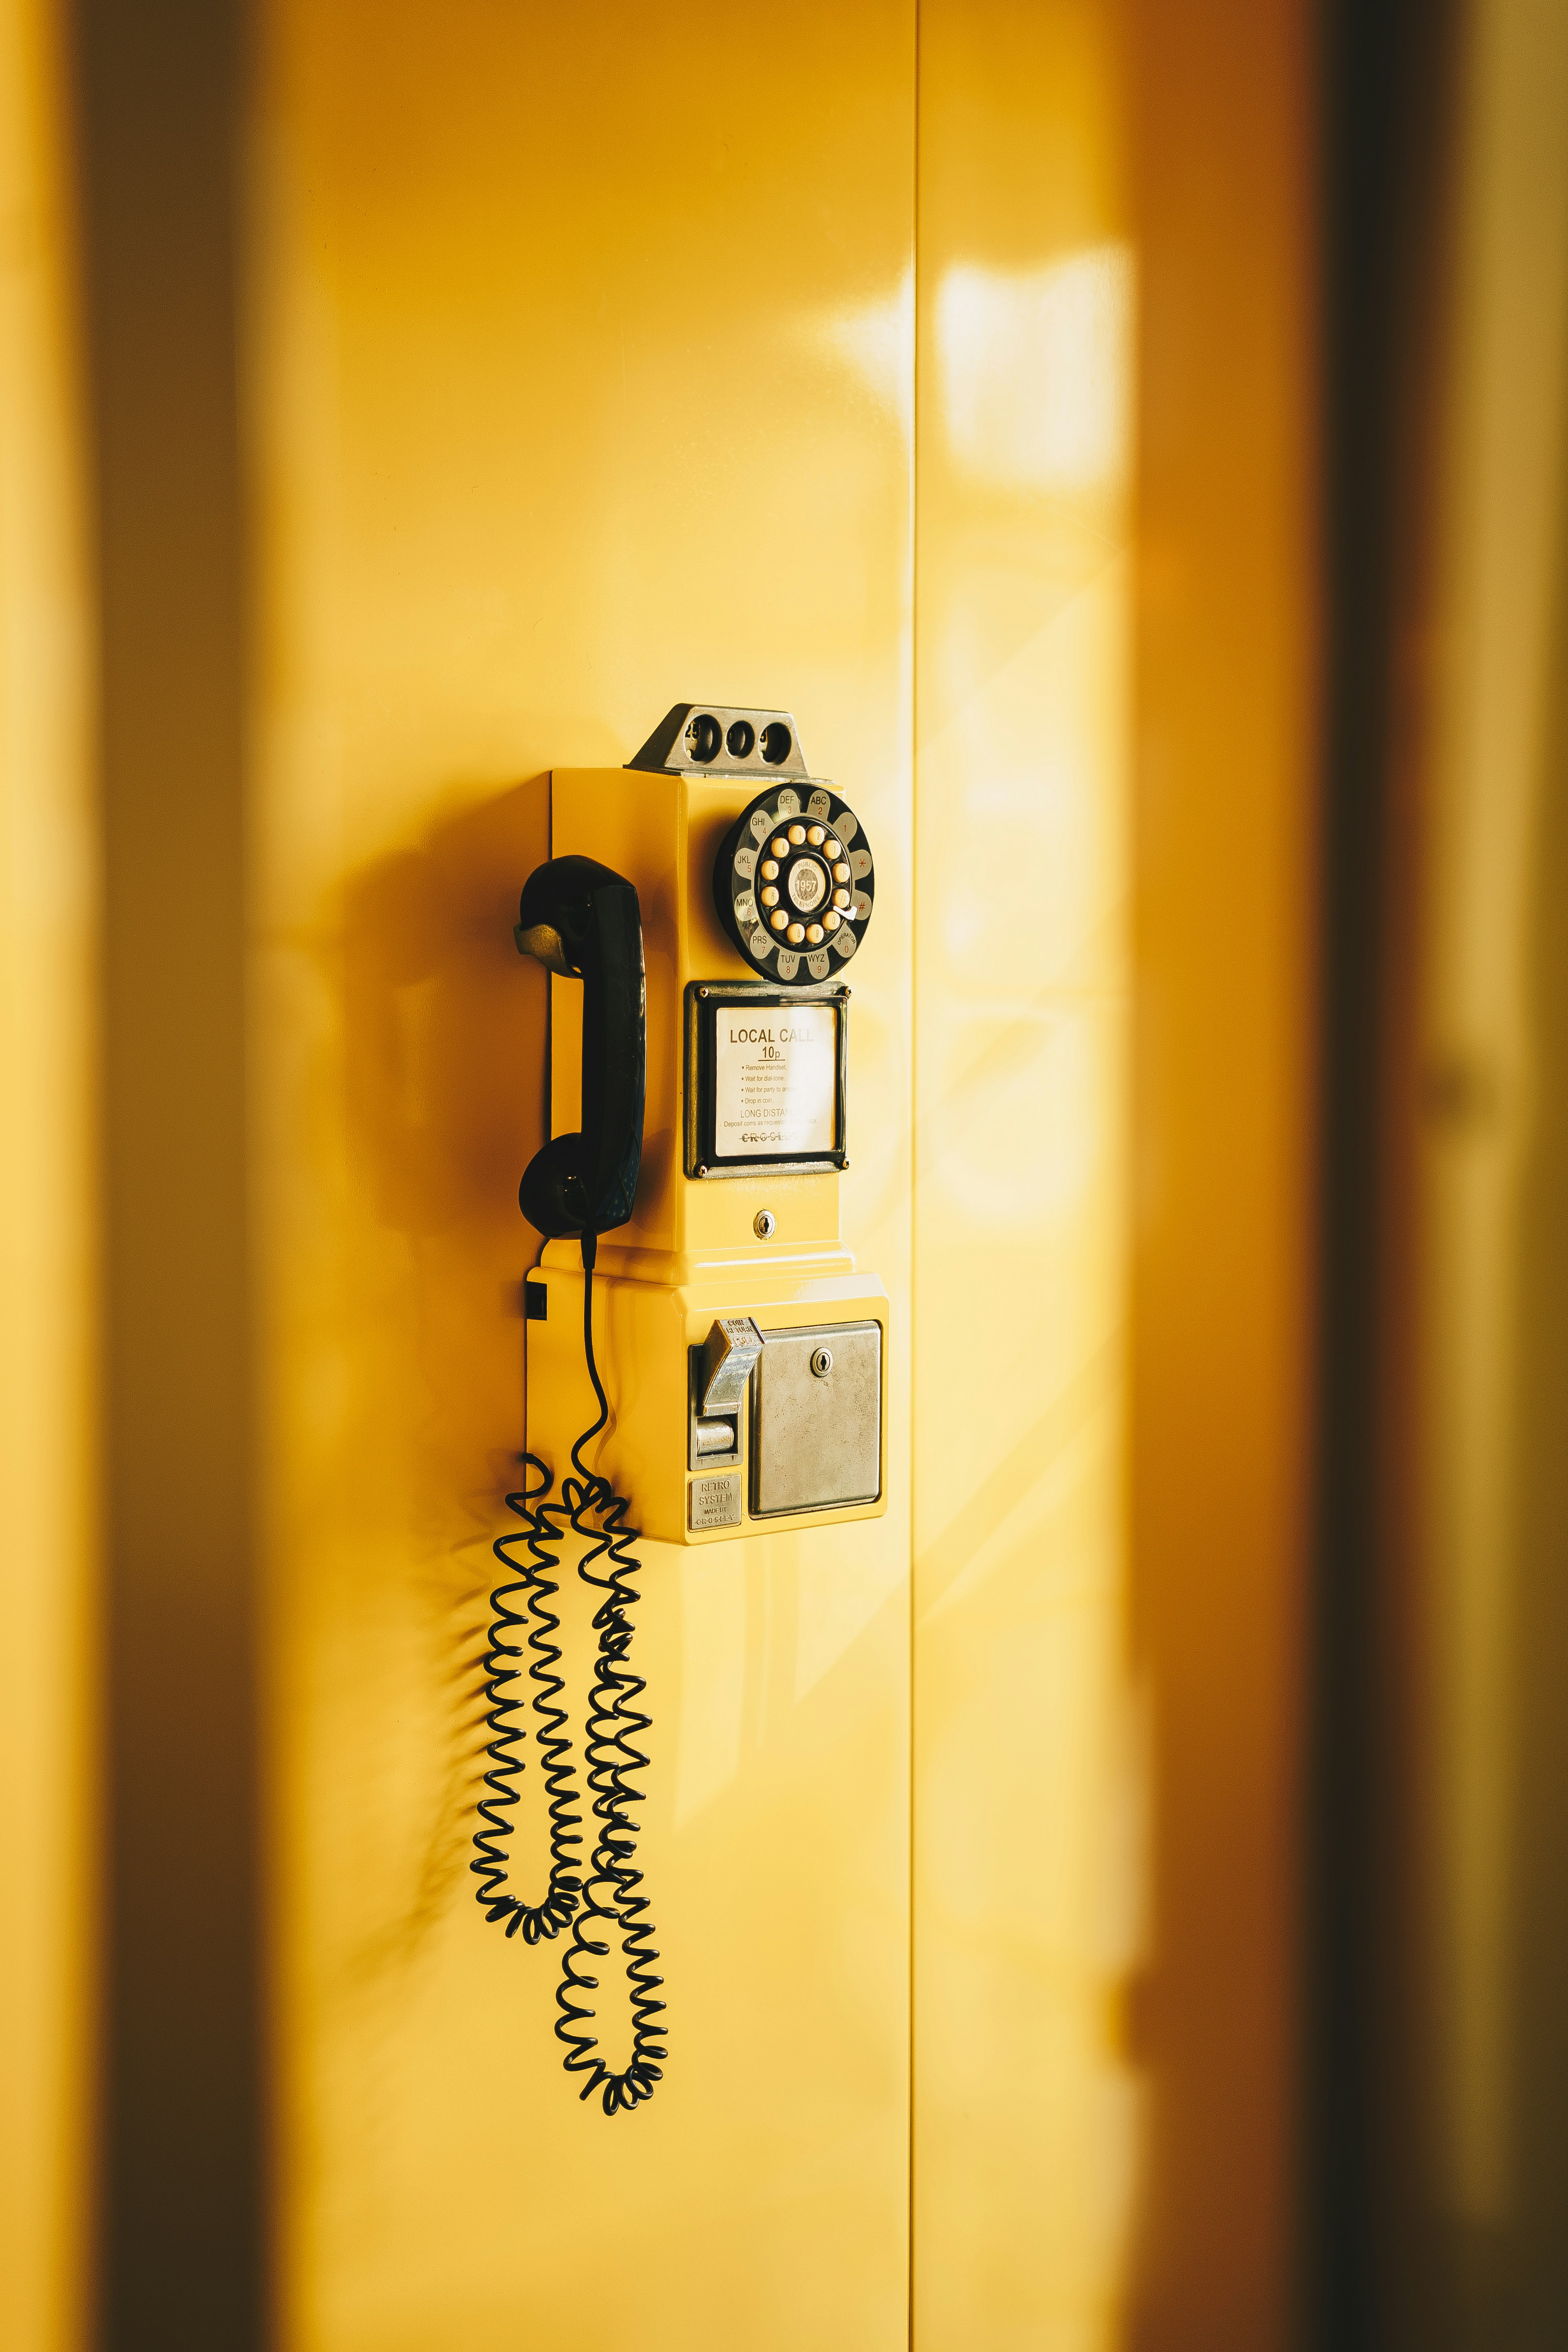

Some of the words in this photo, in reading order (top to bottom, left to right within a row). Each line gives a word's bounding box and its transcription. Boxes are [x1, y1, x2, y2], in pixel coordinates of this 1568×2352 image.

[780, 796, 795, 804] DEF
[810, 796, 826, 805] ABC
[787, 806, 792, 814] 3
[818, 807, 823, 815] 2
[751, 817, 765, 826] GHI
[798, 831, 801, 840] 3
[816, 831, 820, 841] 2
[781, 842, 785, 852] 4
[833, 845, 836, 854] 1
[737, 855, 751, 864] JKL
[747, 865, 751, 873] 5
[798, 861, 817, 871] PUBLIC
[795, 879, 817, 892] 1957
[771, 891, 775, 900] 6
[791, 892, 820, 908] TELEPHONE
[736, 898, 754, 907] MNO
[747, 908, 751, 917] 6
[832, 916, 836, 925] 0
[797, 929, 800, 938] 8
[815, 929, 819, 938] 9
[752, 935, 767, 944] PRS
[837, 933, 856, 945] OPERATOR
[780, 955, 796, 963] TUV
[808, 954, 825, 963] WYZ
[786, 965, 791, 974] 8
[730, 1029, 775, 1043] LOCAL
[779, 1028, 814, 1042] CALL
[762, 1046, 780, 1060] 10p
[740, 1109, 761, 1118] LONG
[763, 1107, 802, 1117] DISTANCE
[764, 1119, 788, 1127] requested
[701, 1480, 730, 1492] RETRO
[699, 1492, 733, 1505] SYSTEM
